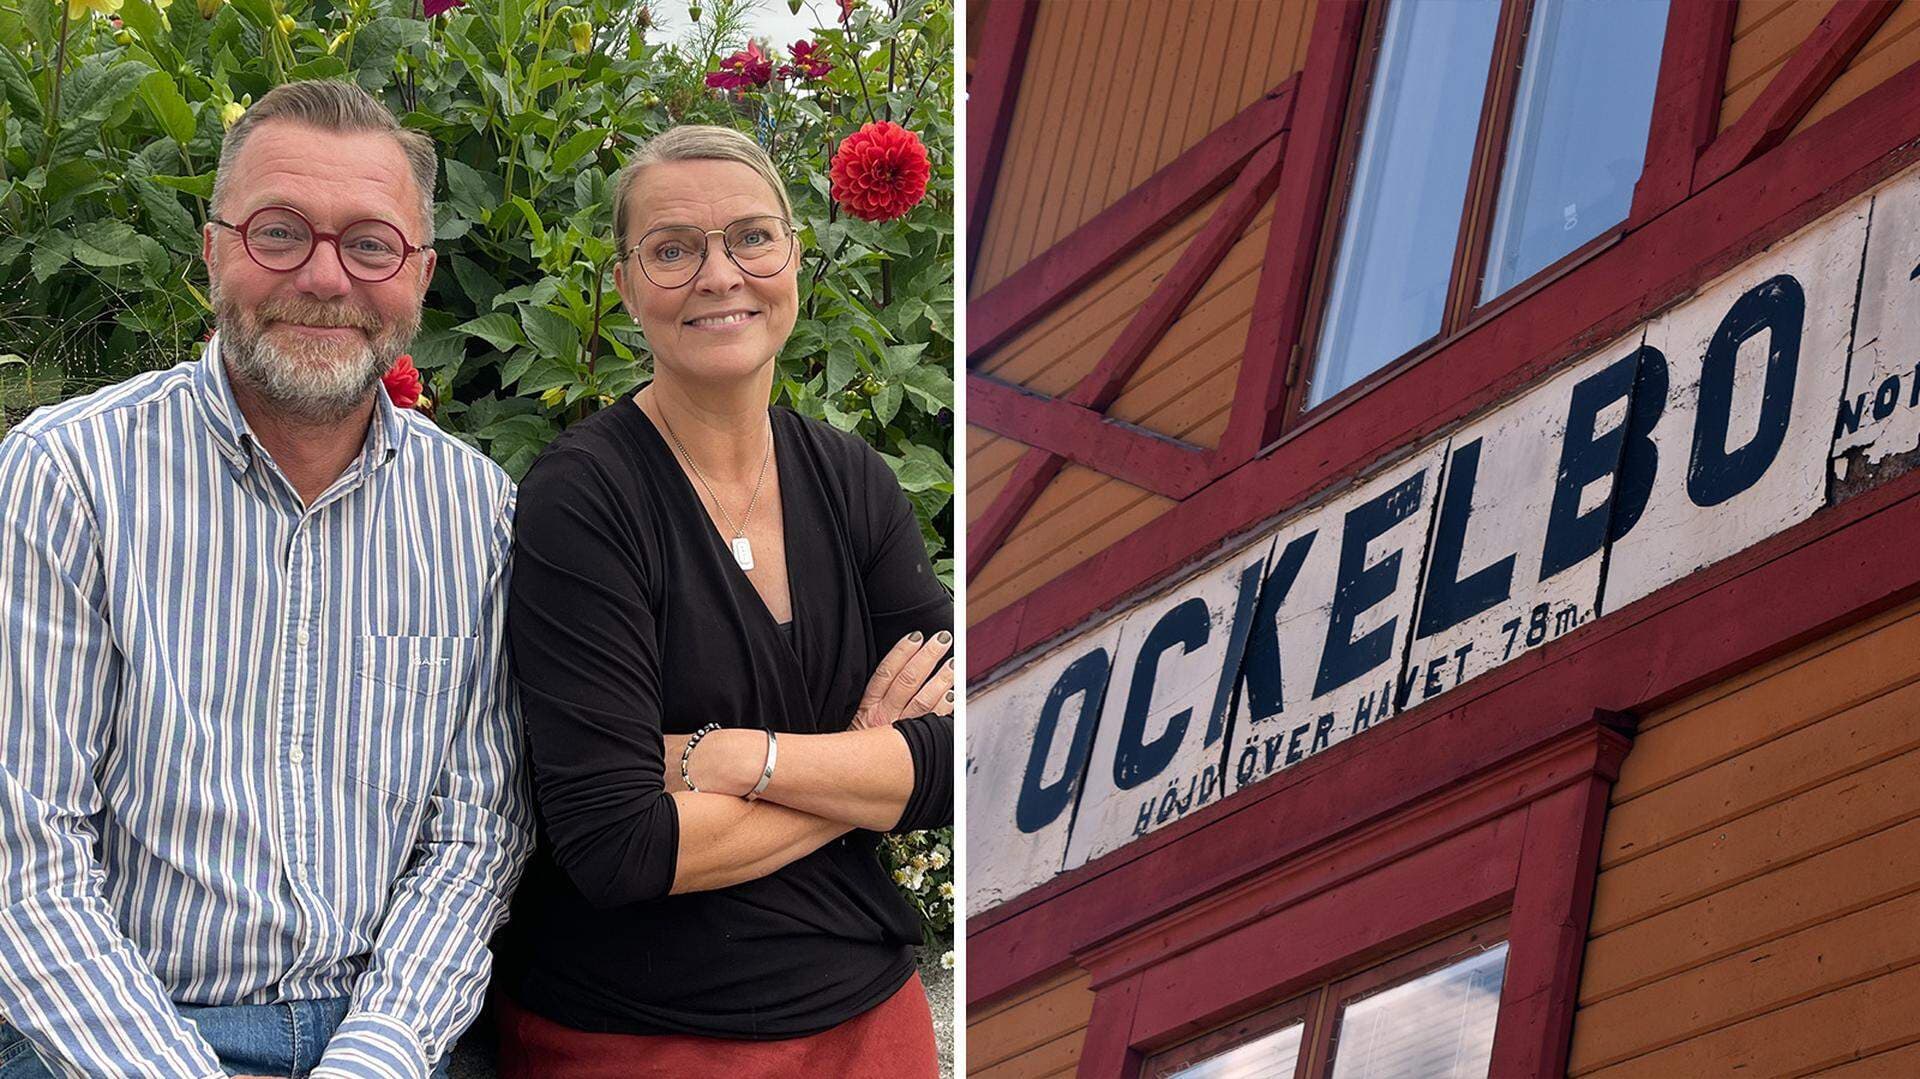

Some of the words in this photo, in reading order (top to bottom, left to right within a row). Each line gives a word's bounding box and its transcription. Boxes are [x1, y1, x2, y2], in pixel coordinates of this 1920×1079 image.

[1016, 273, 1804, 834] OCKELBO
[1132, 764, 1218, 836] HÖJD
[1237, 717, 1333, 786] ÖVER
[1353, 642, 1474, 734] HAVET
